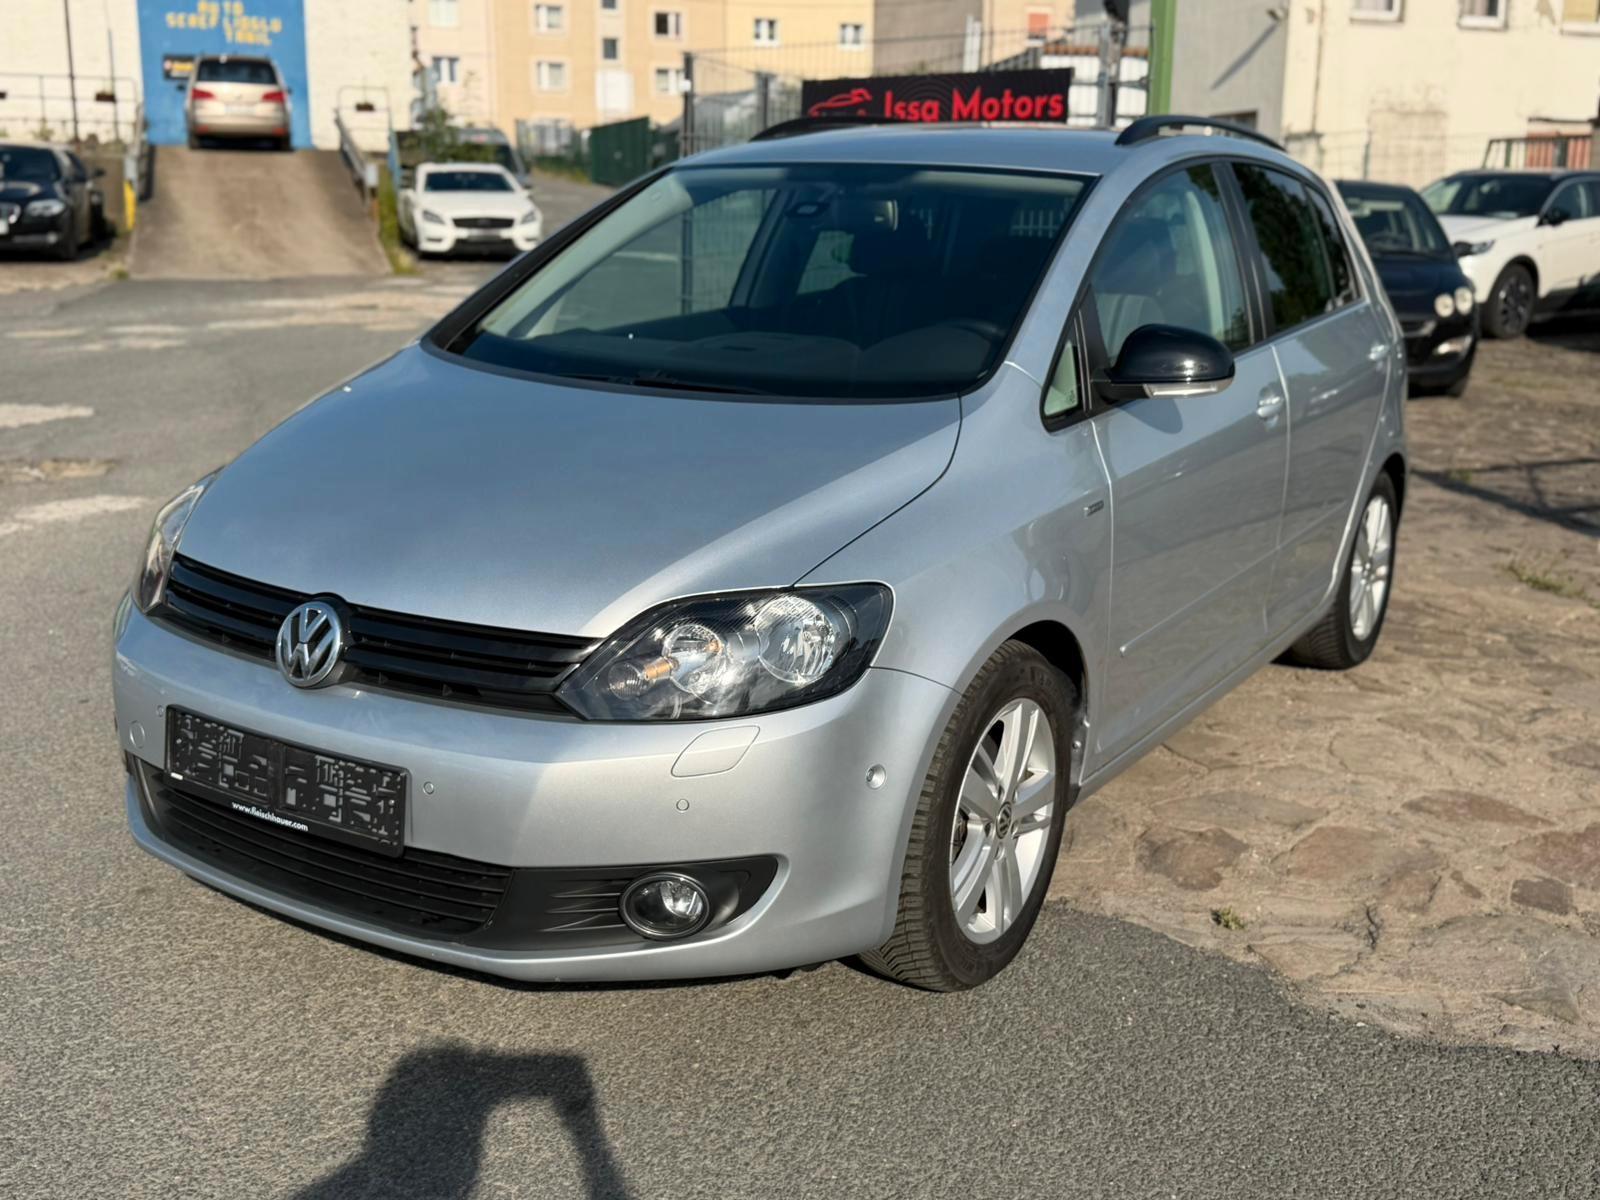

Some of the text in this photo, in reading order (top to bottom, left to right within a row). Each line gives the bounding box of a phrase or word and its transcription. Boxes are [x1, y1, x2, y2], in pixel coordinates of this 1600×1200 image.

[885, 88, 1063, 122] Issa Motors
[277, 601, 341, 688] VW
[231, 801, 309, 832] www.fleischhauer.com
